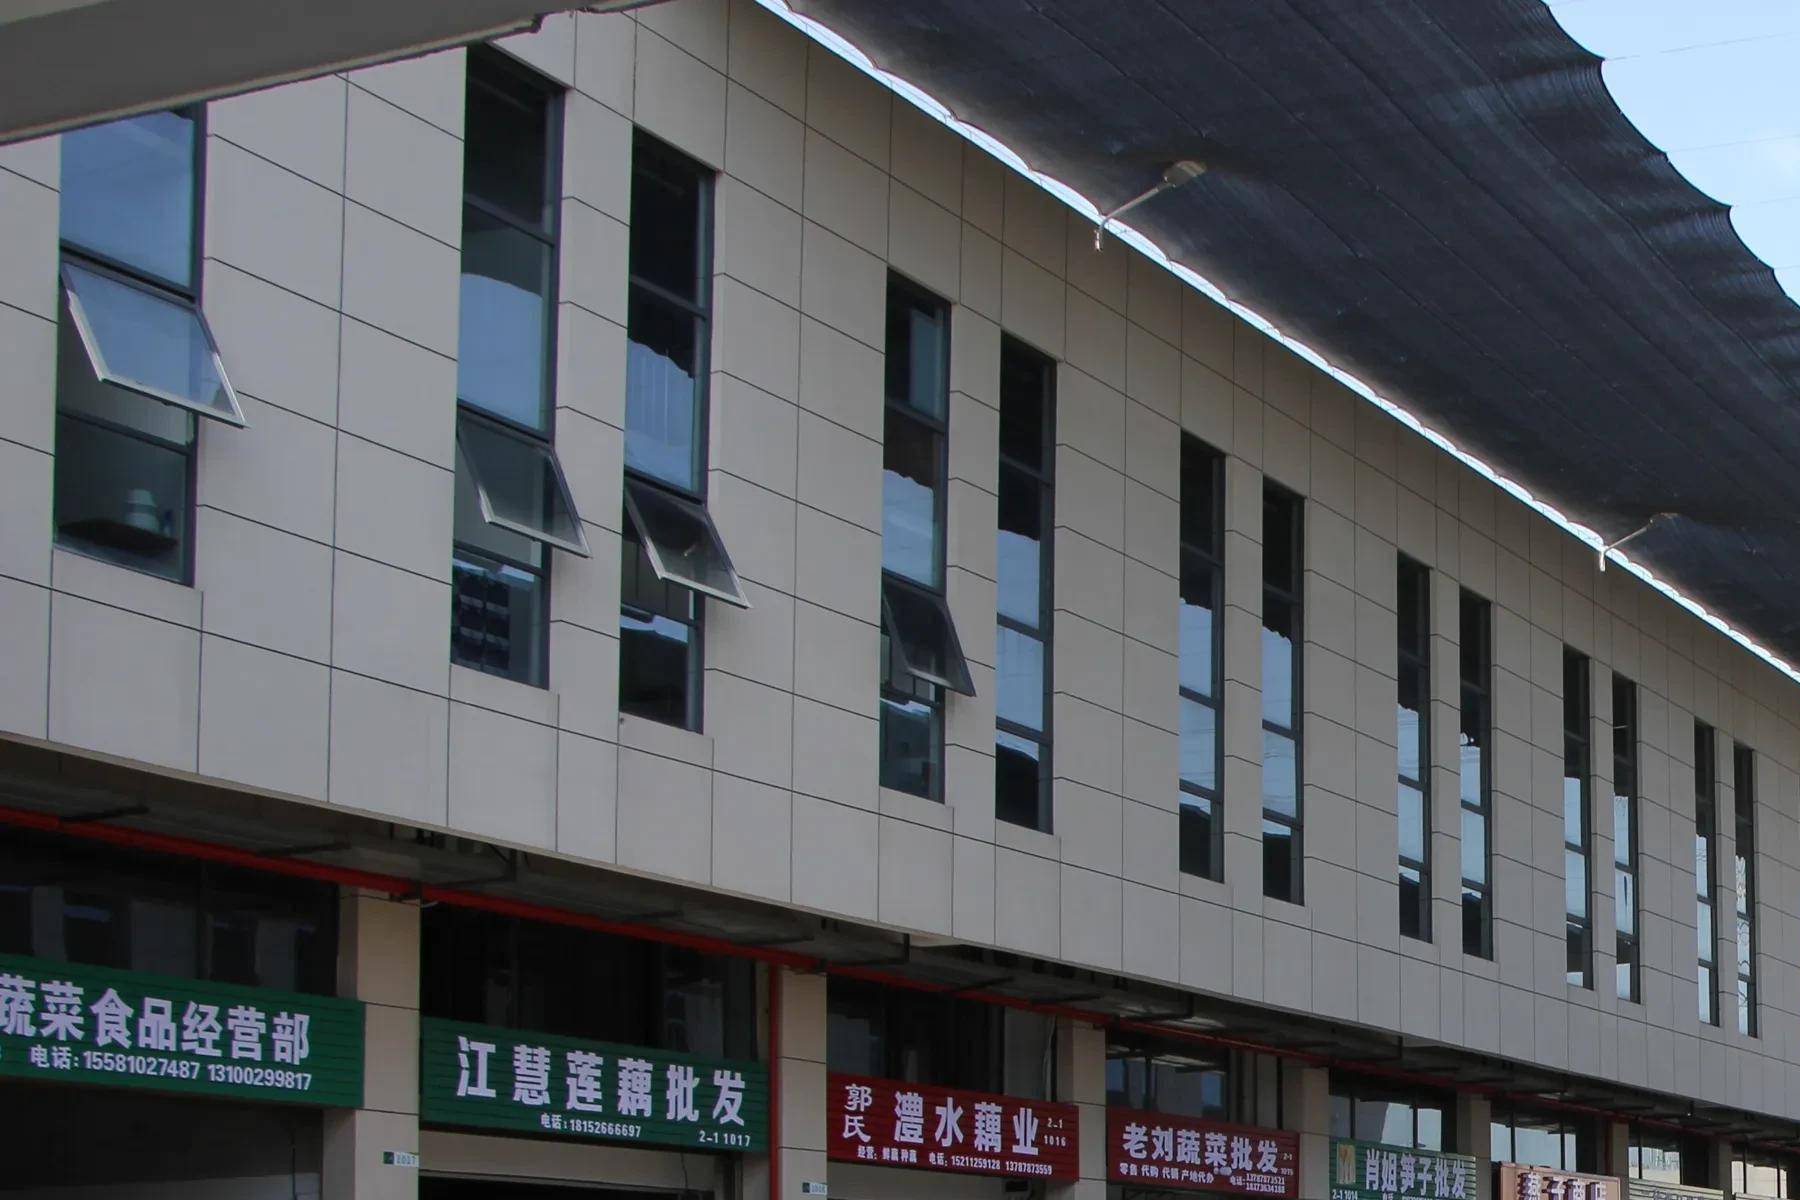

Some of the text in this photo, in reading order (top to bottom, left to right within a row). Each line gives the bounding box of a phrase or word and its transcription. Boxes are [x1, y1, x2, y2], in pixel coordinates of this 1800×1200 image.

[0, 973, 310, 1065] 蔬菜食品经营部
[207, 1063, 312, 1091] 13100299817
[456, 1035, 746, 1127] 江慧莲藕批发
[842, 1083, 873, 1143] 郭氏
[893, 1090, 1040, 1156] 澧水藕业
[1122, 1122, 1279, 1174] 老刘蔬菜批发
[1365, 1148, 1467, 1200] 肖姐笋子批发
